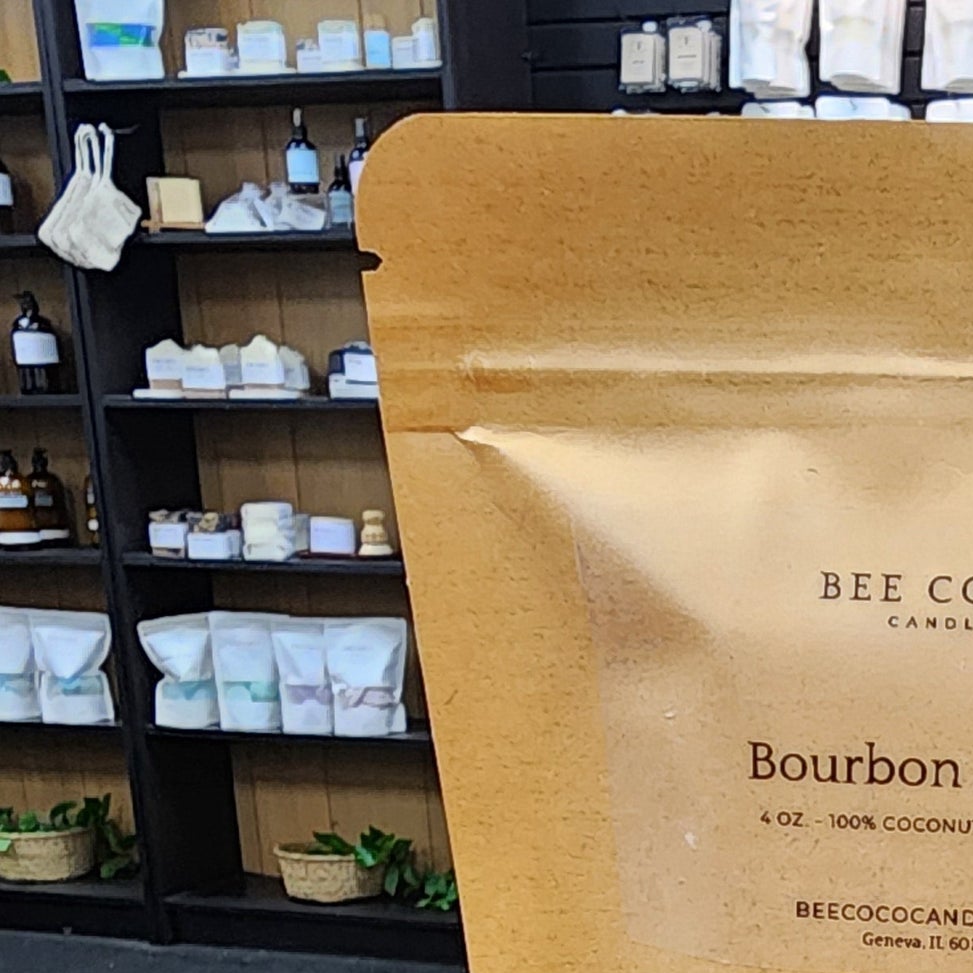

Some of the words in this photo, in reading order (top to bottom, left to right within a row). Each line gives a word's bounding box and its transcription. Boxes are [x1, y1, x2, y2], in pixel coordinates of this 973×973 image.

[819, 571, 903, 602] BEE
[747, 740, 962, 789] Bourbon
[760, 810, 771, 825] 4
[828, 813, 877, 831] 100%
[929, 935, 944, 950] IL
